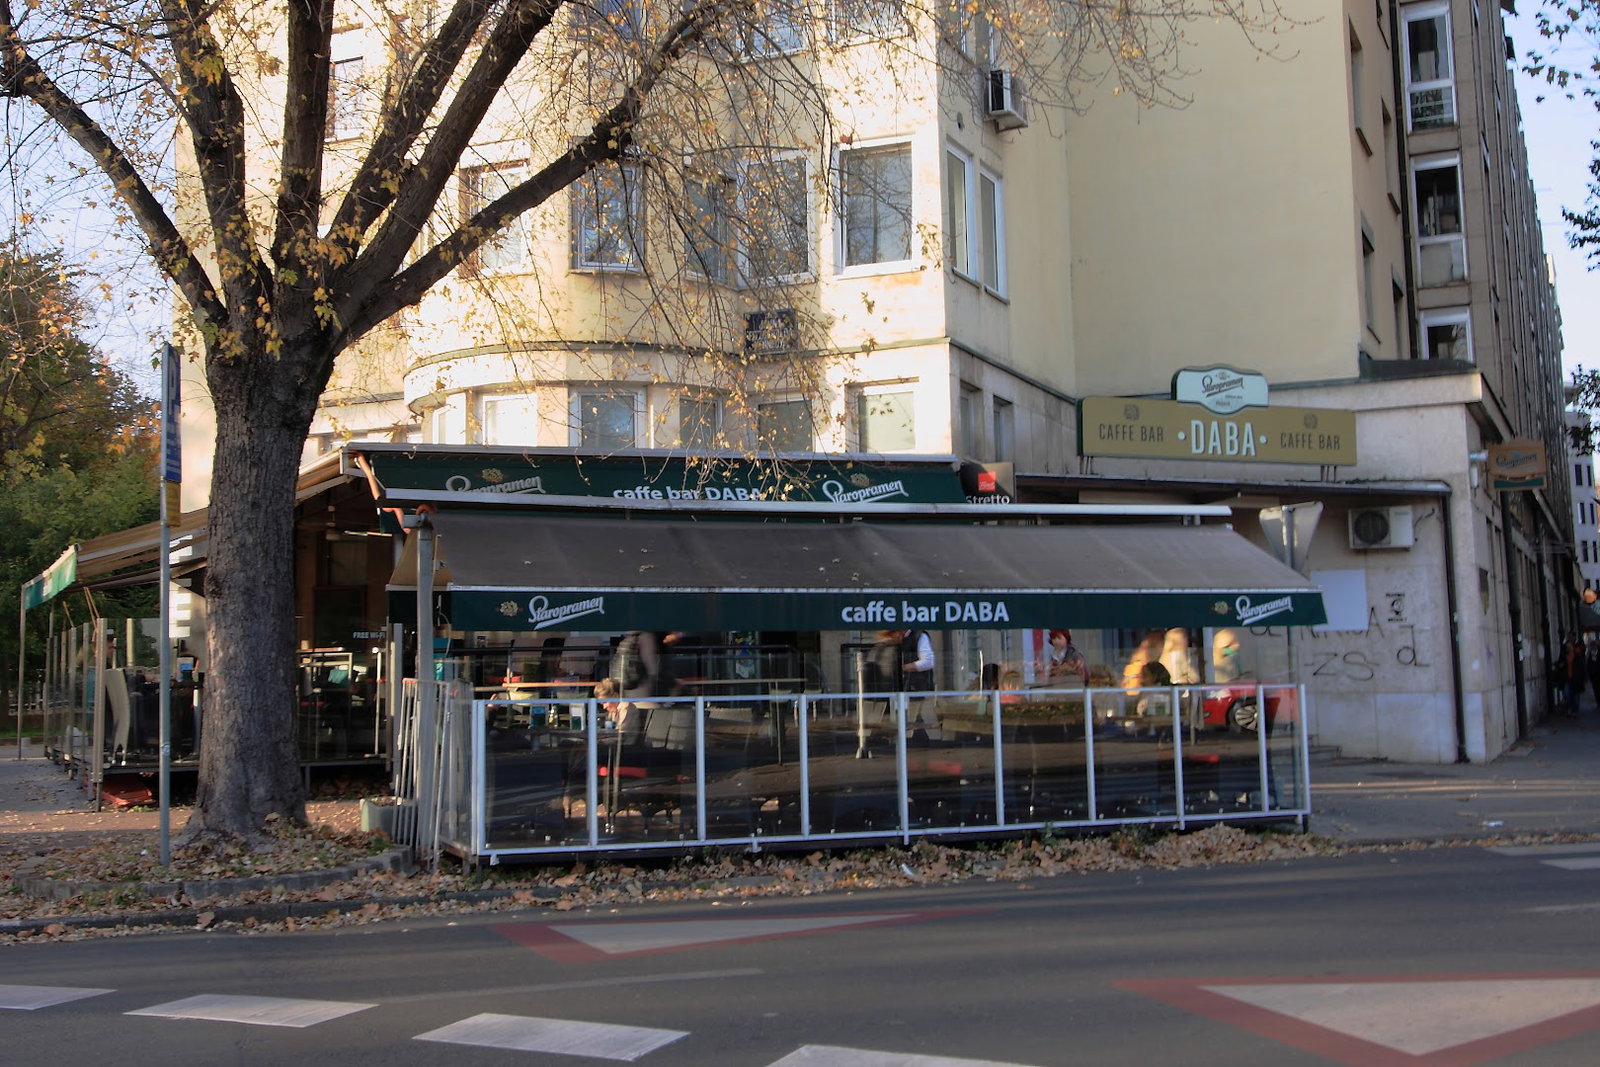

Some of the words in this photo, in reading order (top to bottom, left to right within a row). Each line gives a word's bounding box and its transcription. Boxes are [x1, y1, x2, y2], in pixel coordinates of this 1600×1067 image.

[1098, 423, 1134, 441] CAFFE
[1140, 425, 1164, 442] BAR
[1191, 419, 1256, 457] DABA
[1280, 432, 1313, 450] CAFFE
[1318, 434, 1340, 451] BAR
[613, 486, 663, 500] caffe
[666, 486, 700, 500] bar
[528, 595, 605, 630] Staropramen
[841, 600, 897, 623] caffe
[901, 600, 939, 623] bar
[944, 601, 1010, 623] DABA
[1235, 595, 1294, 626] Staropramen
